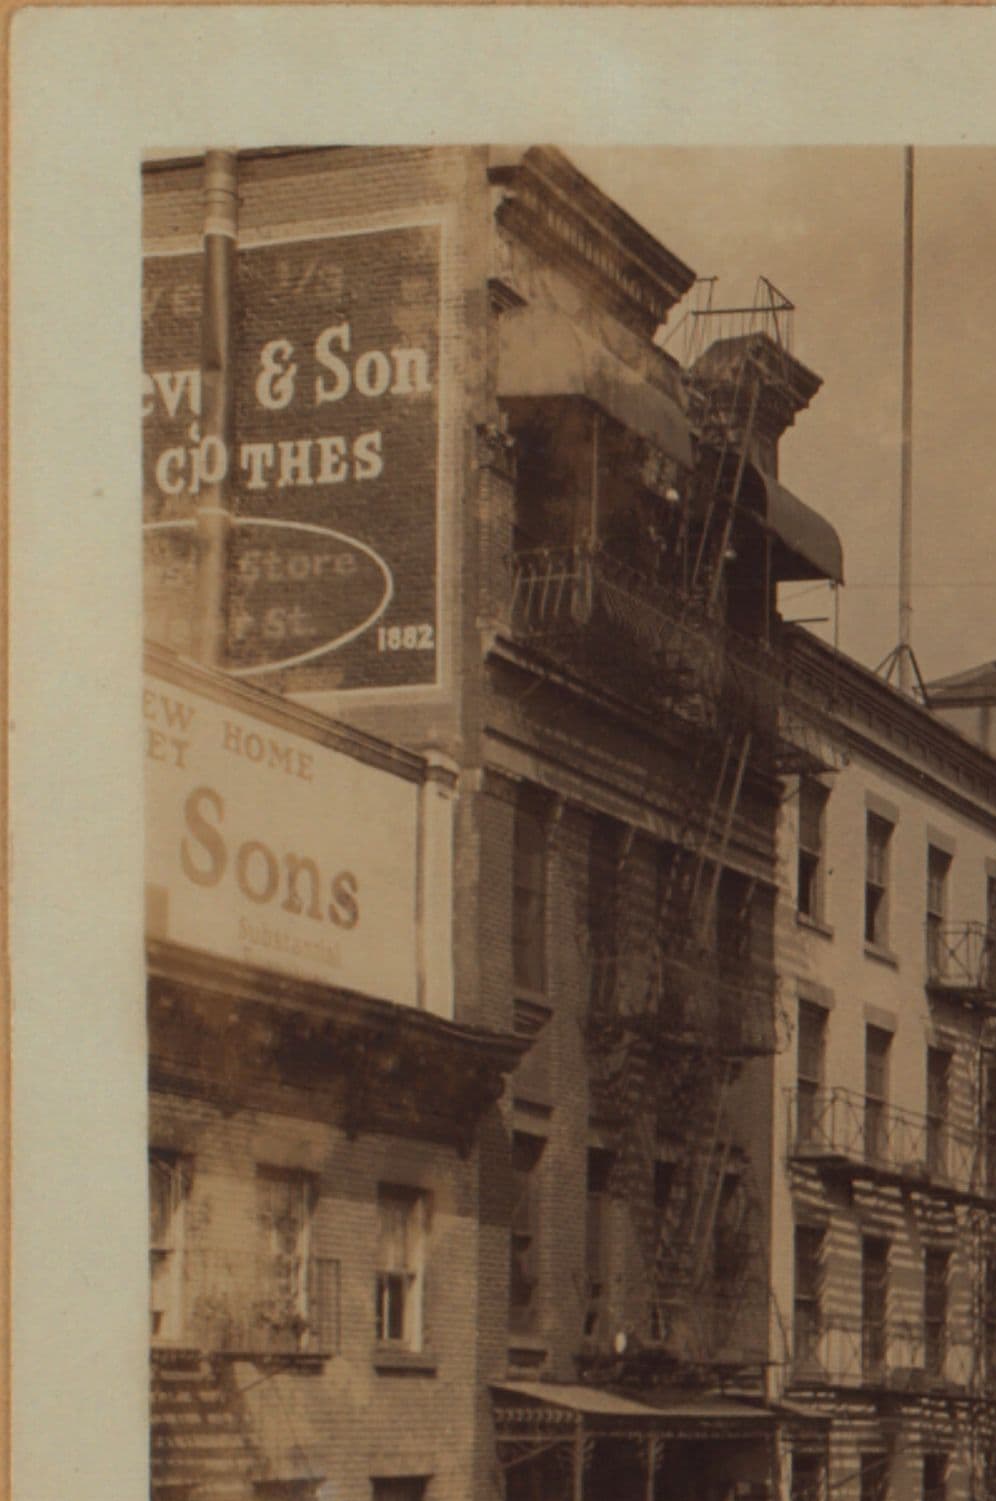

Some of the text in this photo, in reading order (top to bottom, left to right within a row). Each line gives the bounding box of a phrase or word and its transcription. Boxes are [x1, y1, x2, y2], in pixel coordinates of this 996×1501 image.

[256, 338, 298, 410] &
[314, 323, 432, 405] Son
[378, 623, 434, 652] 1882
[147, 727, 191, 770] ET
[221, 719, 315, 783] HOME
[181, 786, 360, 931] Sons
